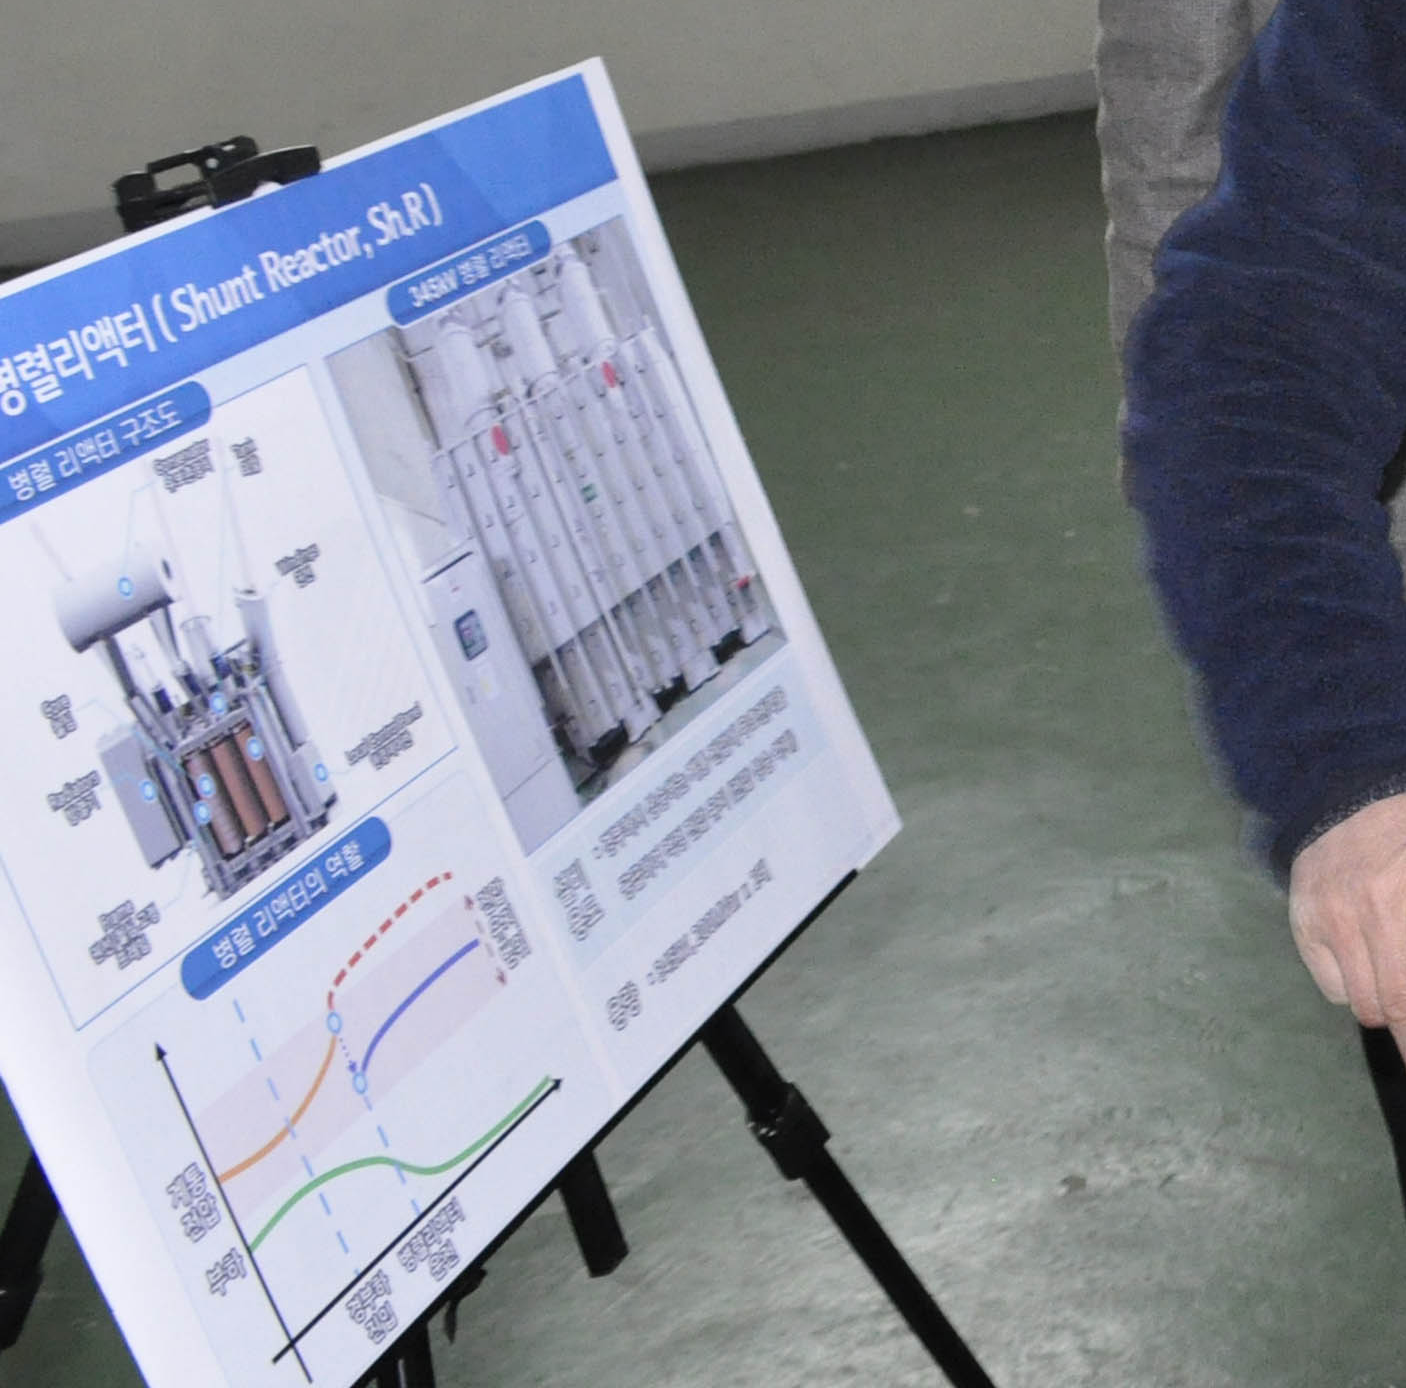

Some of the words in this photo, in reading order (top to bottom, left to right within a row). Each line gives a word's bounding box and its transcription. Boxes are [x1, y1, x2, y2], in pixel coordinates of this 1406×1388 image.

[8, 459, 57, 501] 병렬
[54, 429, 121, 478] 리액터
[119, 399, 183, 446] 구조도
[212, 921, 256, 969] 병렬
[252, 867, 328, 937] 리액터의
[205, 1247, 248, 1297] 부하
